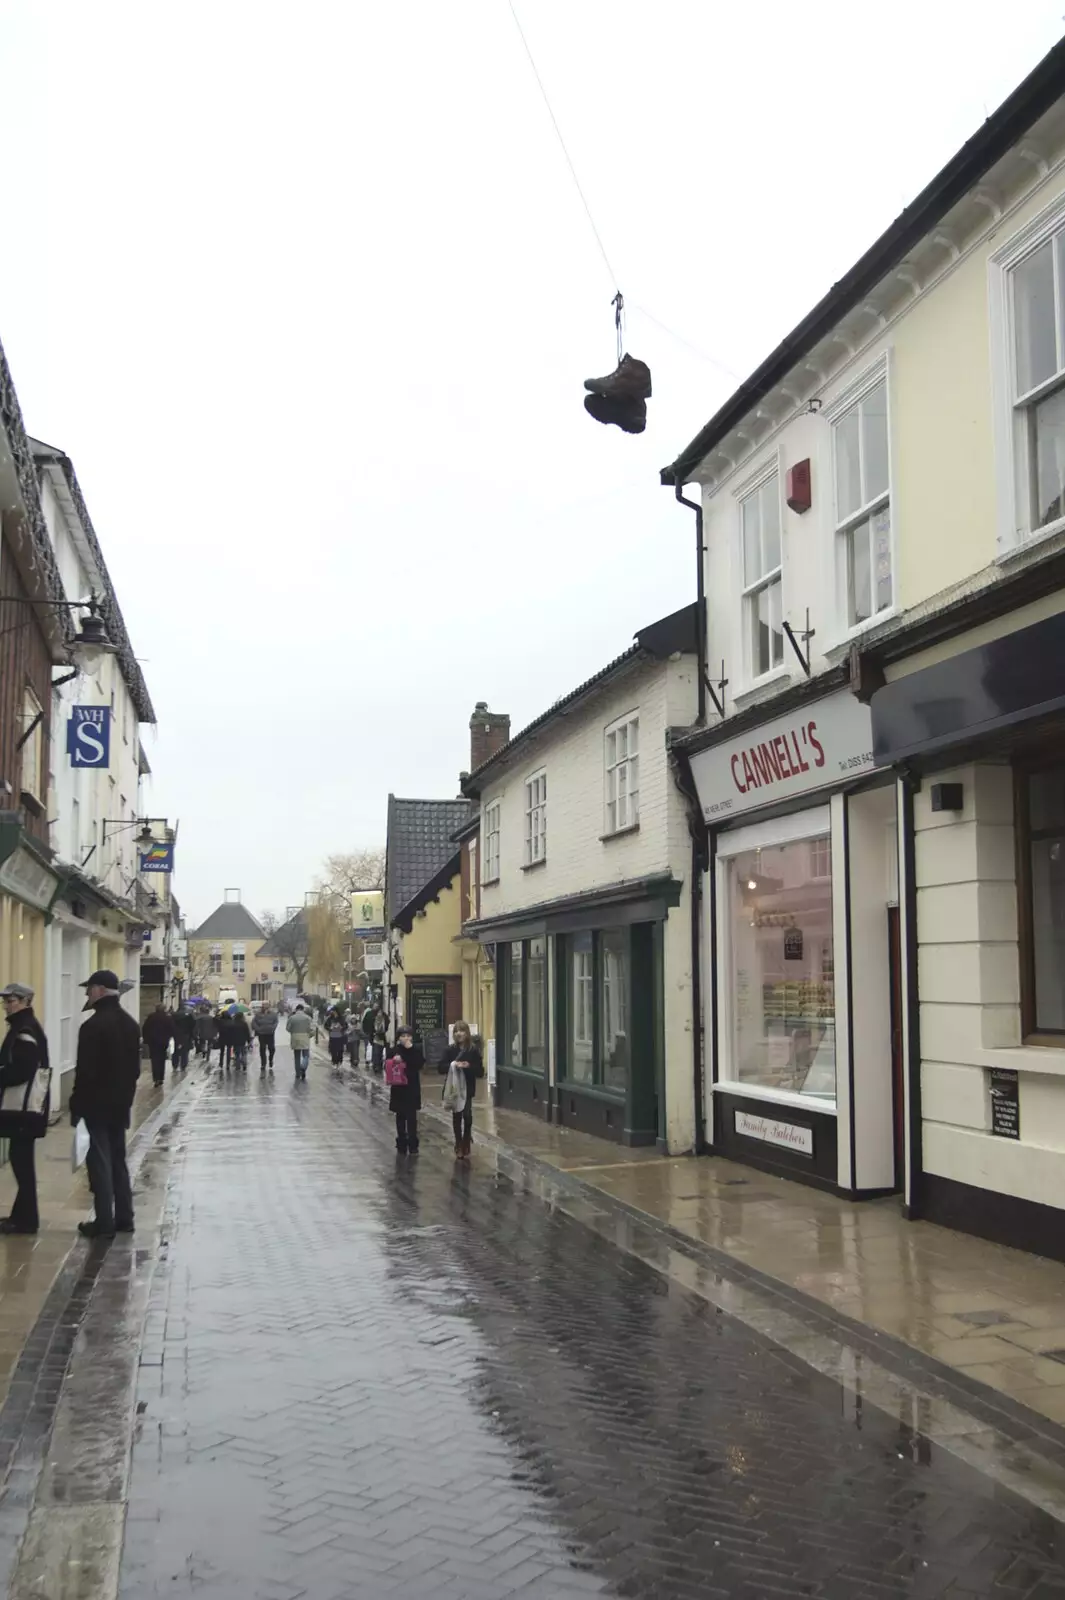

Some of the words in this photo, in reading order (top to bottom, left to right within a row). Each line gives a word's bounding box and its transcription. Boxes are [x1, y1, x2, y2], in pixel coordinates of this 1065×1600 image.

[77, 709, 104, 722] WH
[75, 722, 104, 764] S
[730, 721, 825, 794] CANNELL'S
